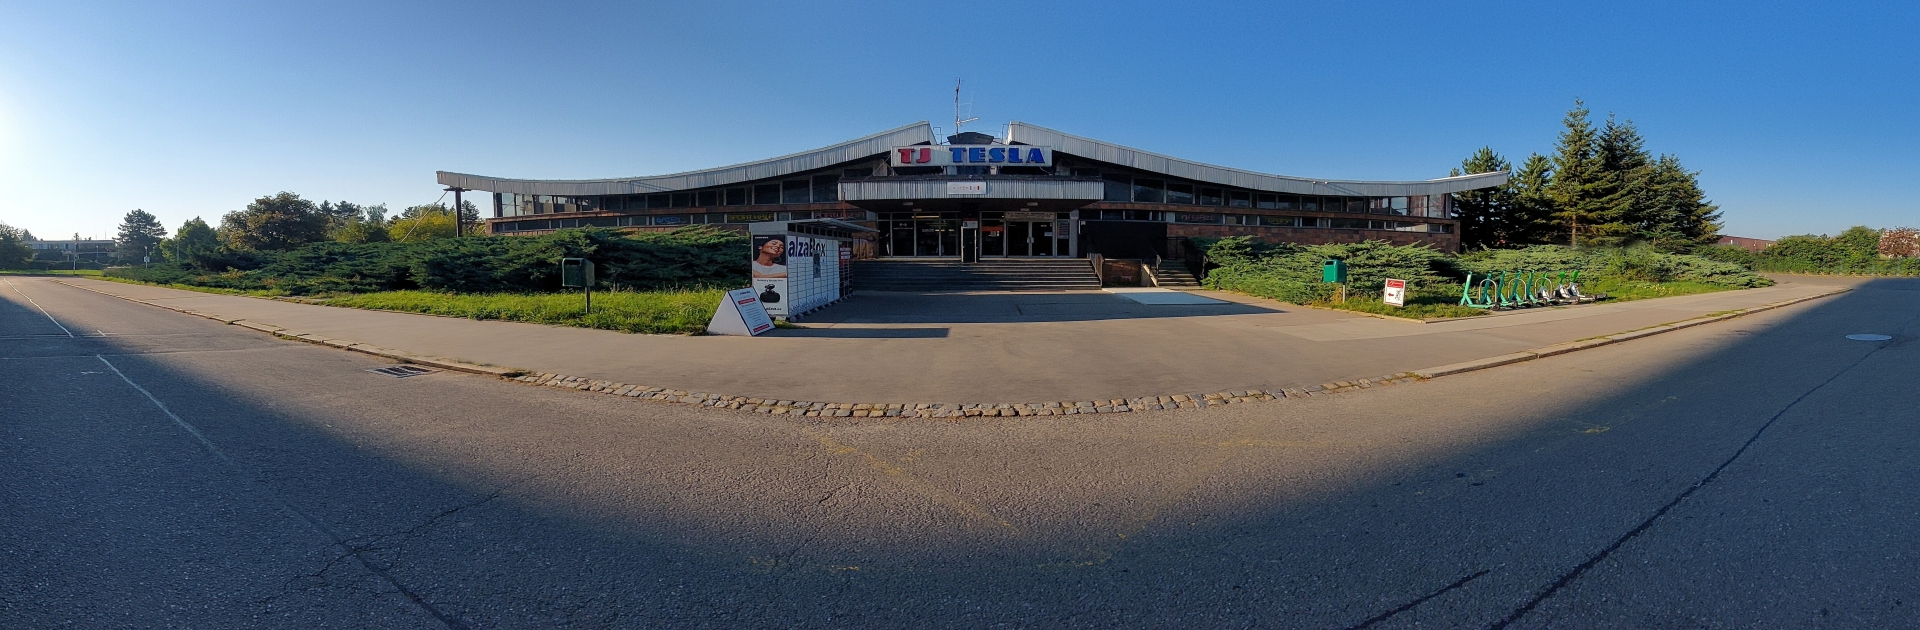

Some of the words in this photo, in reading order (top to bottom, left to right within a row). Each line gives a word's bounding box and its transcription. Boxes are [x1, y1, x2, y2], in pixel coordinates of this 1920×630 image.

[898, 147, 931, 164] TJ
[949, 147, 1045, 164] TESLA
[788, 236, 826, 257] alzaBox
